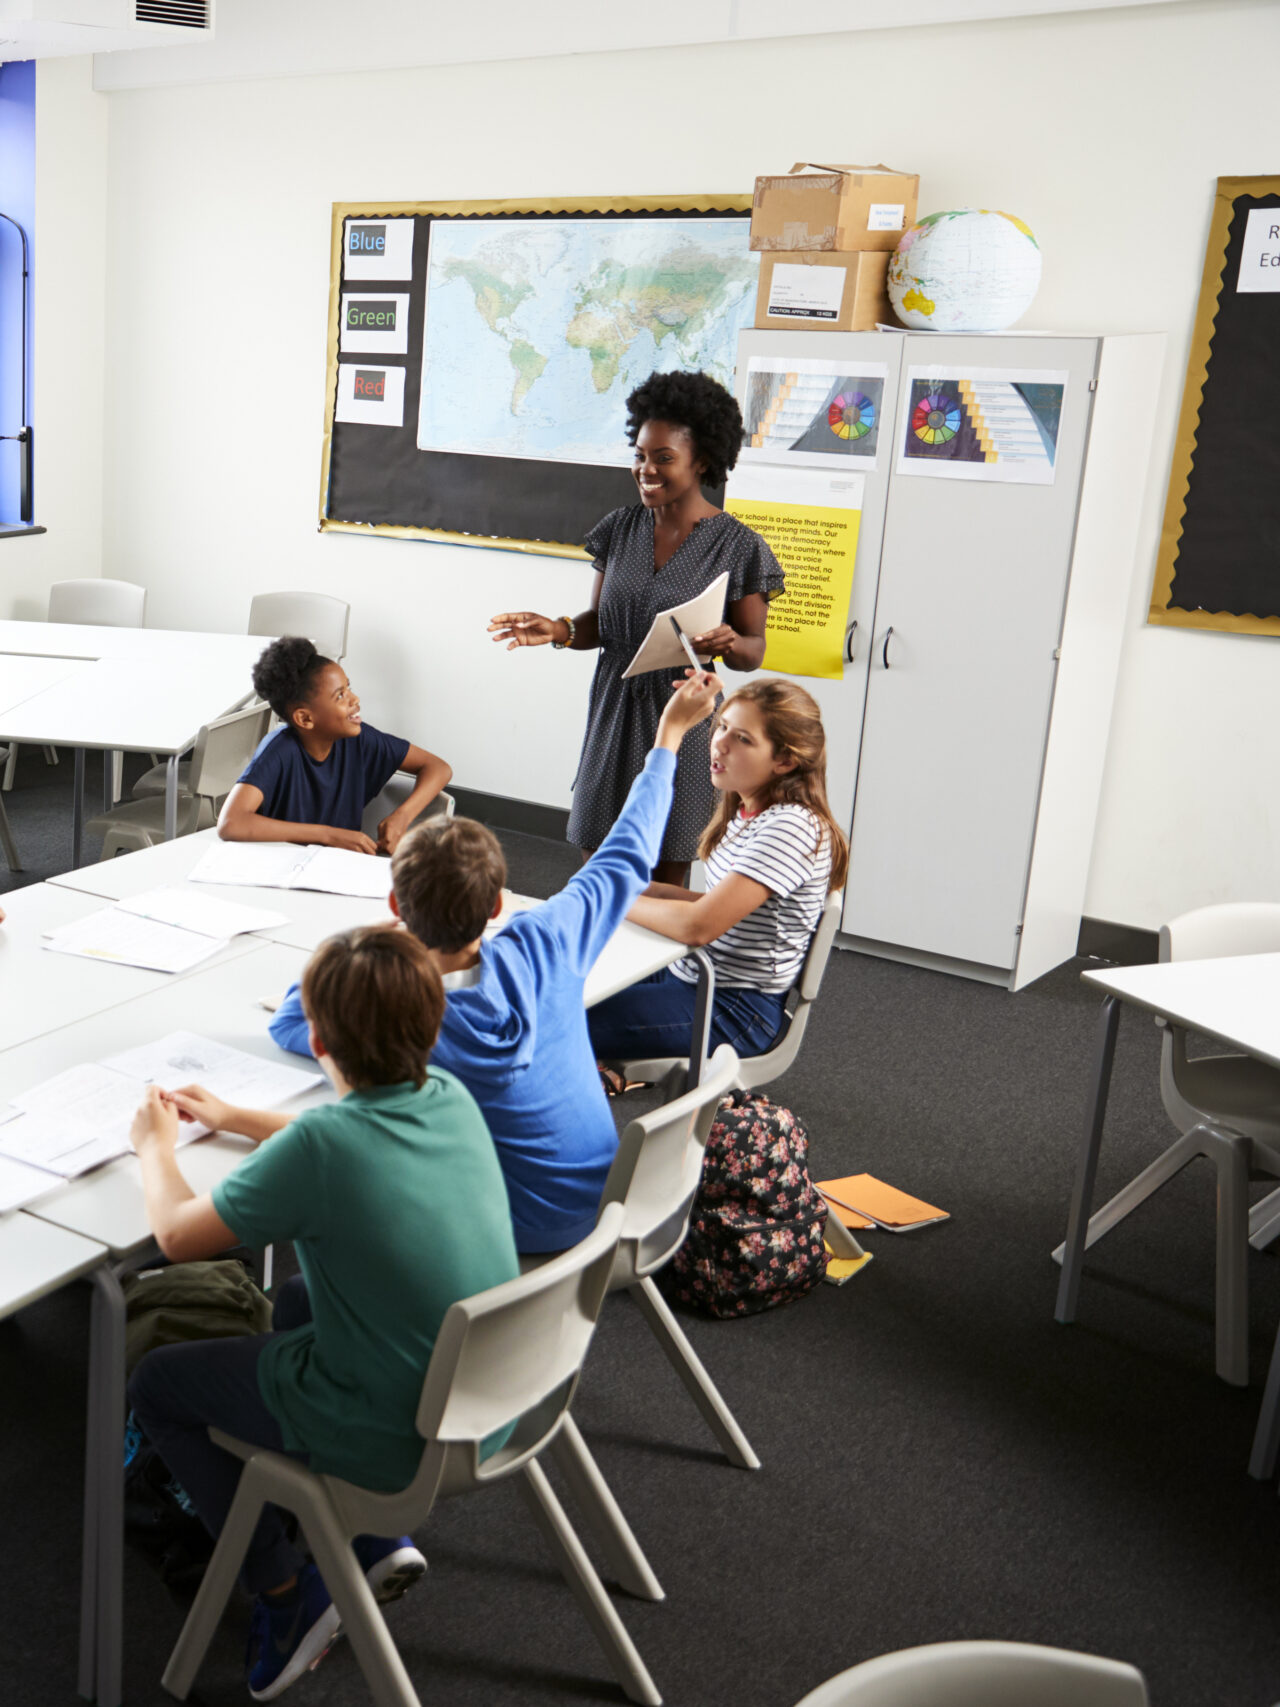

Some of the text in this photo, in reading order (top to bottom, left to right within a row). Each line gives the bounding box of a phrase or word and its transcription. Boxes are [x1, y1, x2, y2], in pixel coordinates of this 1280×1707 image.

[350, 232, 385, 251] Blue
[347, 307, 396, 326] Green
[355, 377, 385, 396] Red
[731, 511, 744, 519] Our
[745, 513, 768, 521] school
[820, 520, 848, 529] inspires
[777, 526, 798, 535] young
[800, 528, 822, 536] minds.
[791, 536, 831, 547] democracy
[793, 546, 821, 555] country,
[823, 549, 846, 557] where
[784, 563, 822, 573] respected,
[809, 574, 831, 582] belief.
[785, 581, 823, 591] discussion,
[793, 590, 809, 598] from
[811, 593, 835, 601] others.
[804, 601, 832, 609] division
[794, 618, 816, 626] place
[776, 624, 801, 632] school.
